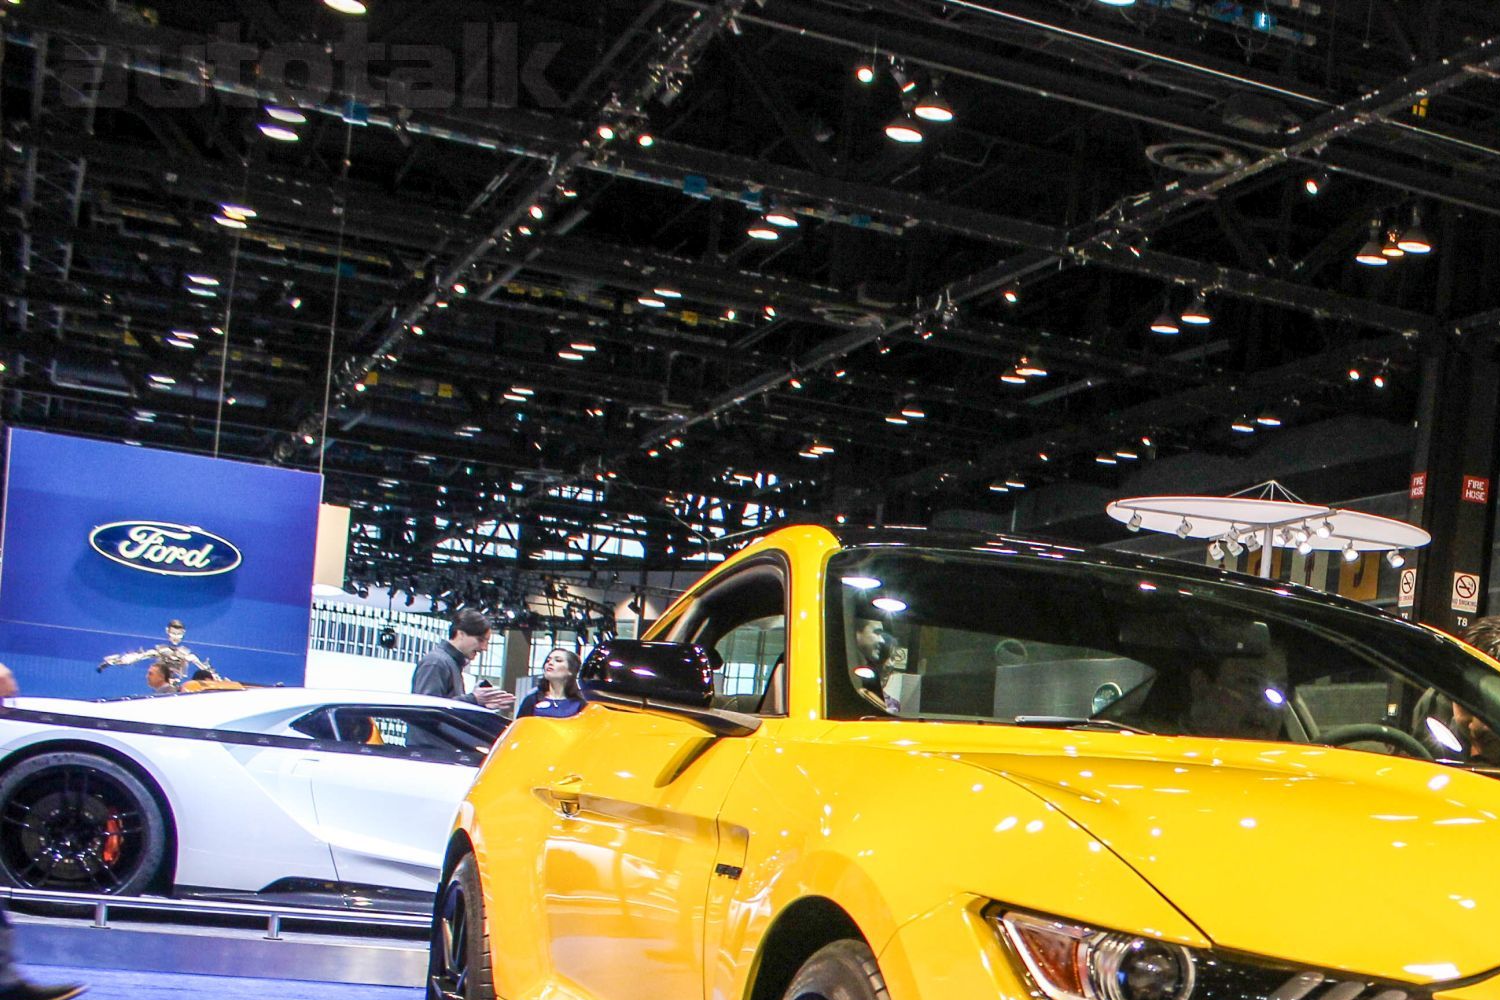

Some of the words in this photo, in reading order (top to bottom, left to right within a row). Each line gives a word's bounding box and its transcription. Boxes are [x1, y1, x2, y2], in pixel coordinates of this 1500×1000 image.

[1467, 479, 1485, 491] FIRE
[1465, 488, 1485, 501] HOSE
[117, 525, 214, 569] Ford
[1456, 616, 1468, 627] T8
